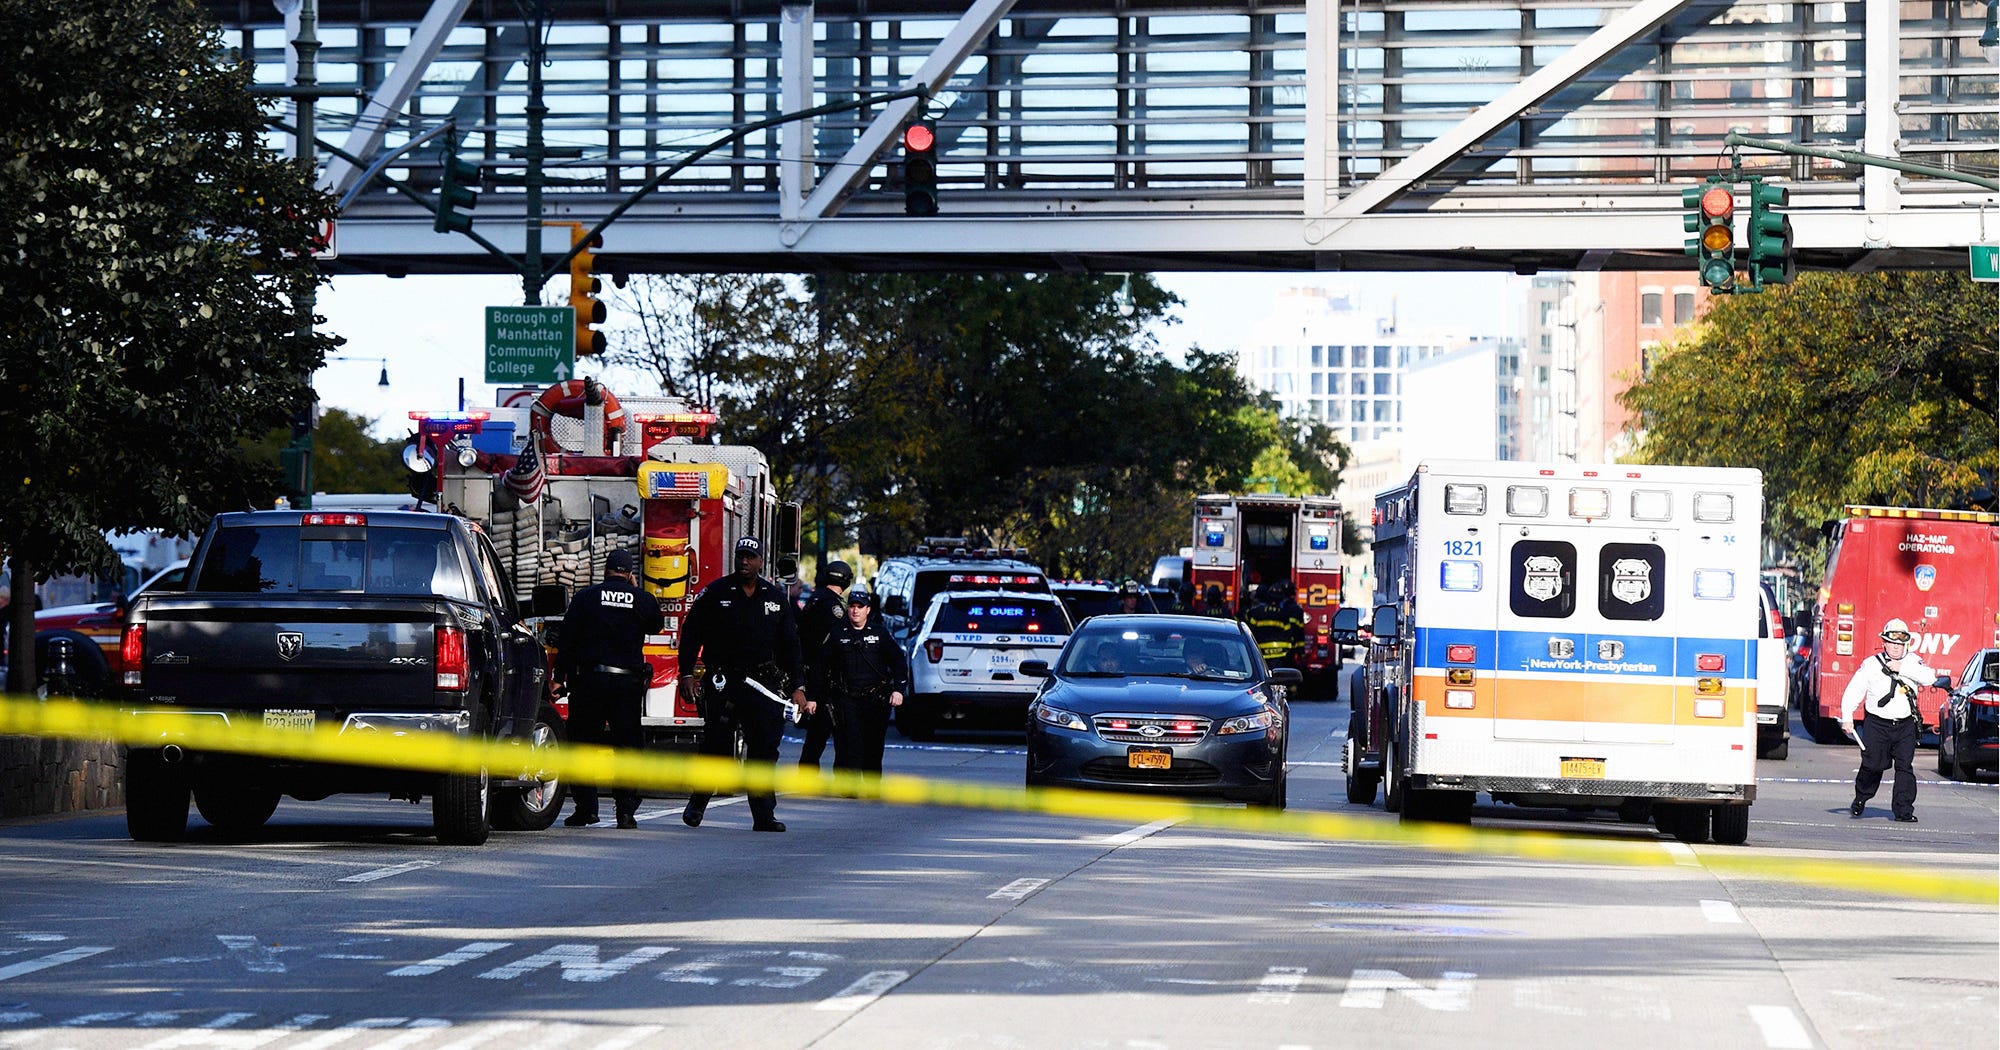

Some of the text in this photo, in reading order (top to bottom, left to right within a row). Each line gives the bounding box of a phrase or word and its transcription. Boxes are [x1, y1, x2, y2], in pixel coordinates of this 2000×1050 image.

[494, 311, 564, 327] Borough of
[497, 328, 562, 340] Manhattan
[489, 344, 561, 360] Community
[489, 361, 535, 377] College
[739, 539, 758, 549] NYPD
[1906, 534, 1948, 544] HAZ-MAT
[1443, 540, 1482, 556] 1821
[1898, 543, 1955, 554] OPERATIONS
[601, 590, 634, 604] NYPD
[1308, 584, 1328, 607] 2
[660, 603, 682, 612] 200
[1020, 635, 1055, 643] POLICE
[1907, 631, 1960, 655] DNY
[991, 655, 1009, 663] 5294
[1530, 659, 1657, 673] NewYork-Presbyterian
